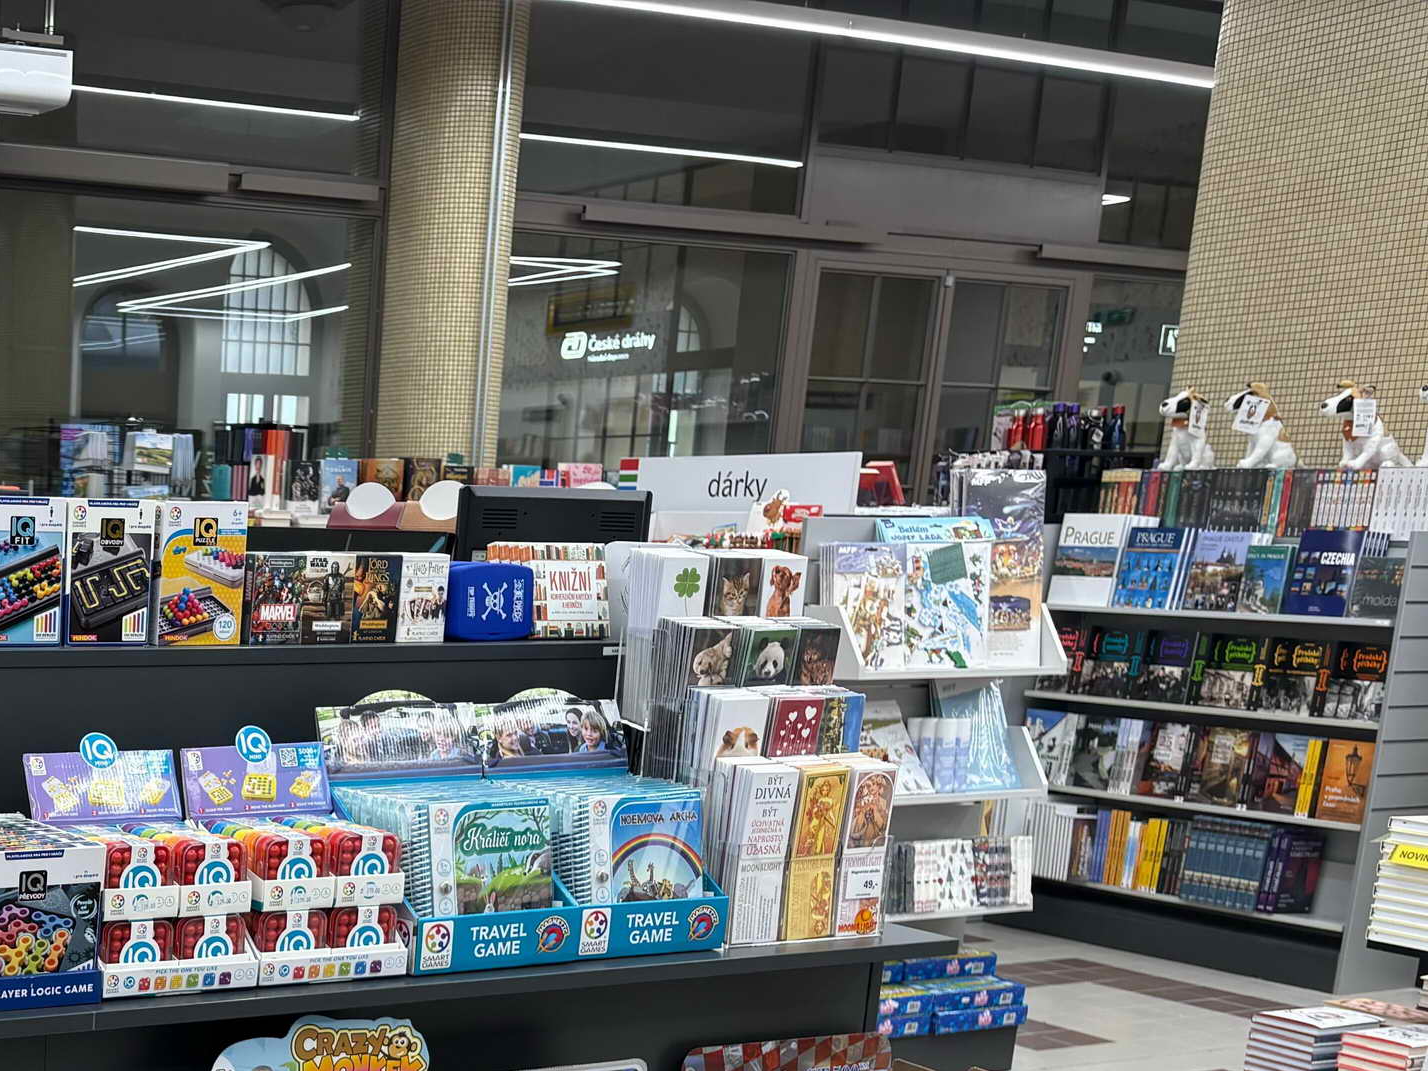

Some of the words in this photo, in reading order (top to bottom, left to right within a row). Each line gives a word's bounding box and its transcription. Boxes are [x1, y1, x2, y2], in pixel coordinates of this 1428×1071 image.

[588, 334, 621, 351] České
[621, 332, 655, 350] dráhy
[708, 469, 768, 502] dárky
[11, 516, 34, 537] IQ
[1064, 526, 1114, 544] PRAGUE
[1321, 552, 1355, 566] CZECHIA
[550, 566, 591, 591] KNIŽNÍ
[261, 606, 296, 621] MARVEL
[755, 783, 791, 800] DIVNÁ
[620, 813, 665, 826] NOEMOVA
[669, 811, 697, 822] ARCHA
[462, 827, 511, 850] Králičí
[514, 831, 541, 847] nora
[863, 879, 878, 890] 49,-
[19, 891, 46, 900] PŘEVODY
[626, 911, 679, 928] TRAVEL
[471, 923, 527, 941] TRAVEL
[629, 926, 673, 945] GAME
[474, 940, 521, 958] GAME
[31, 985, 63, 996] LOGIC
[67, 983, 93, 994] GAME
[295, 1027, 389, 1060] CRAZY
